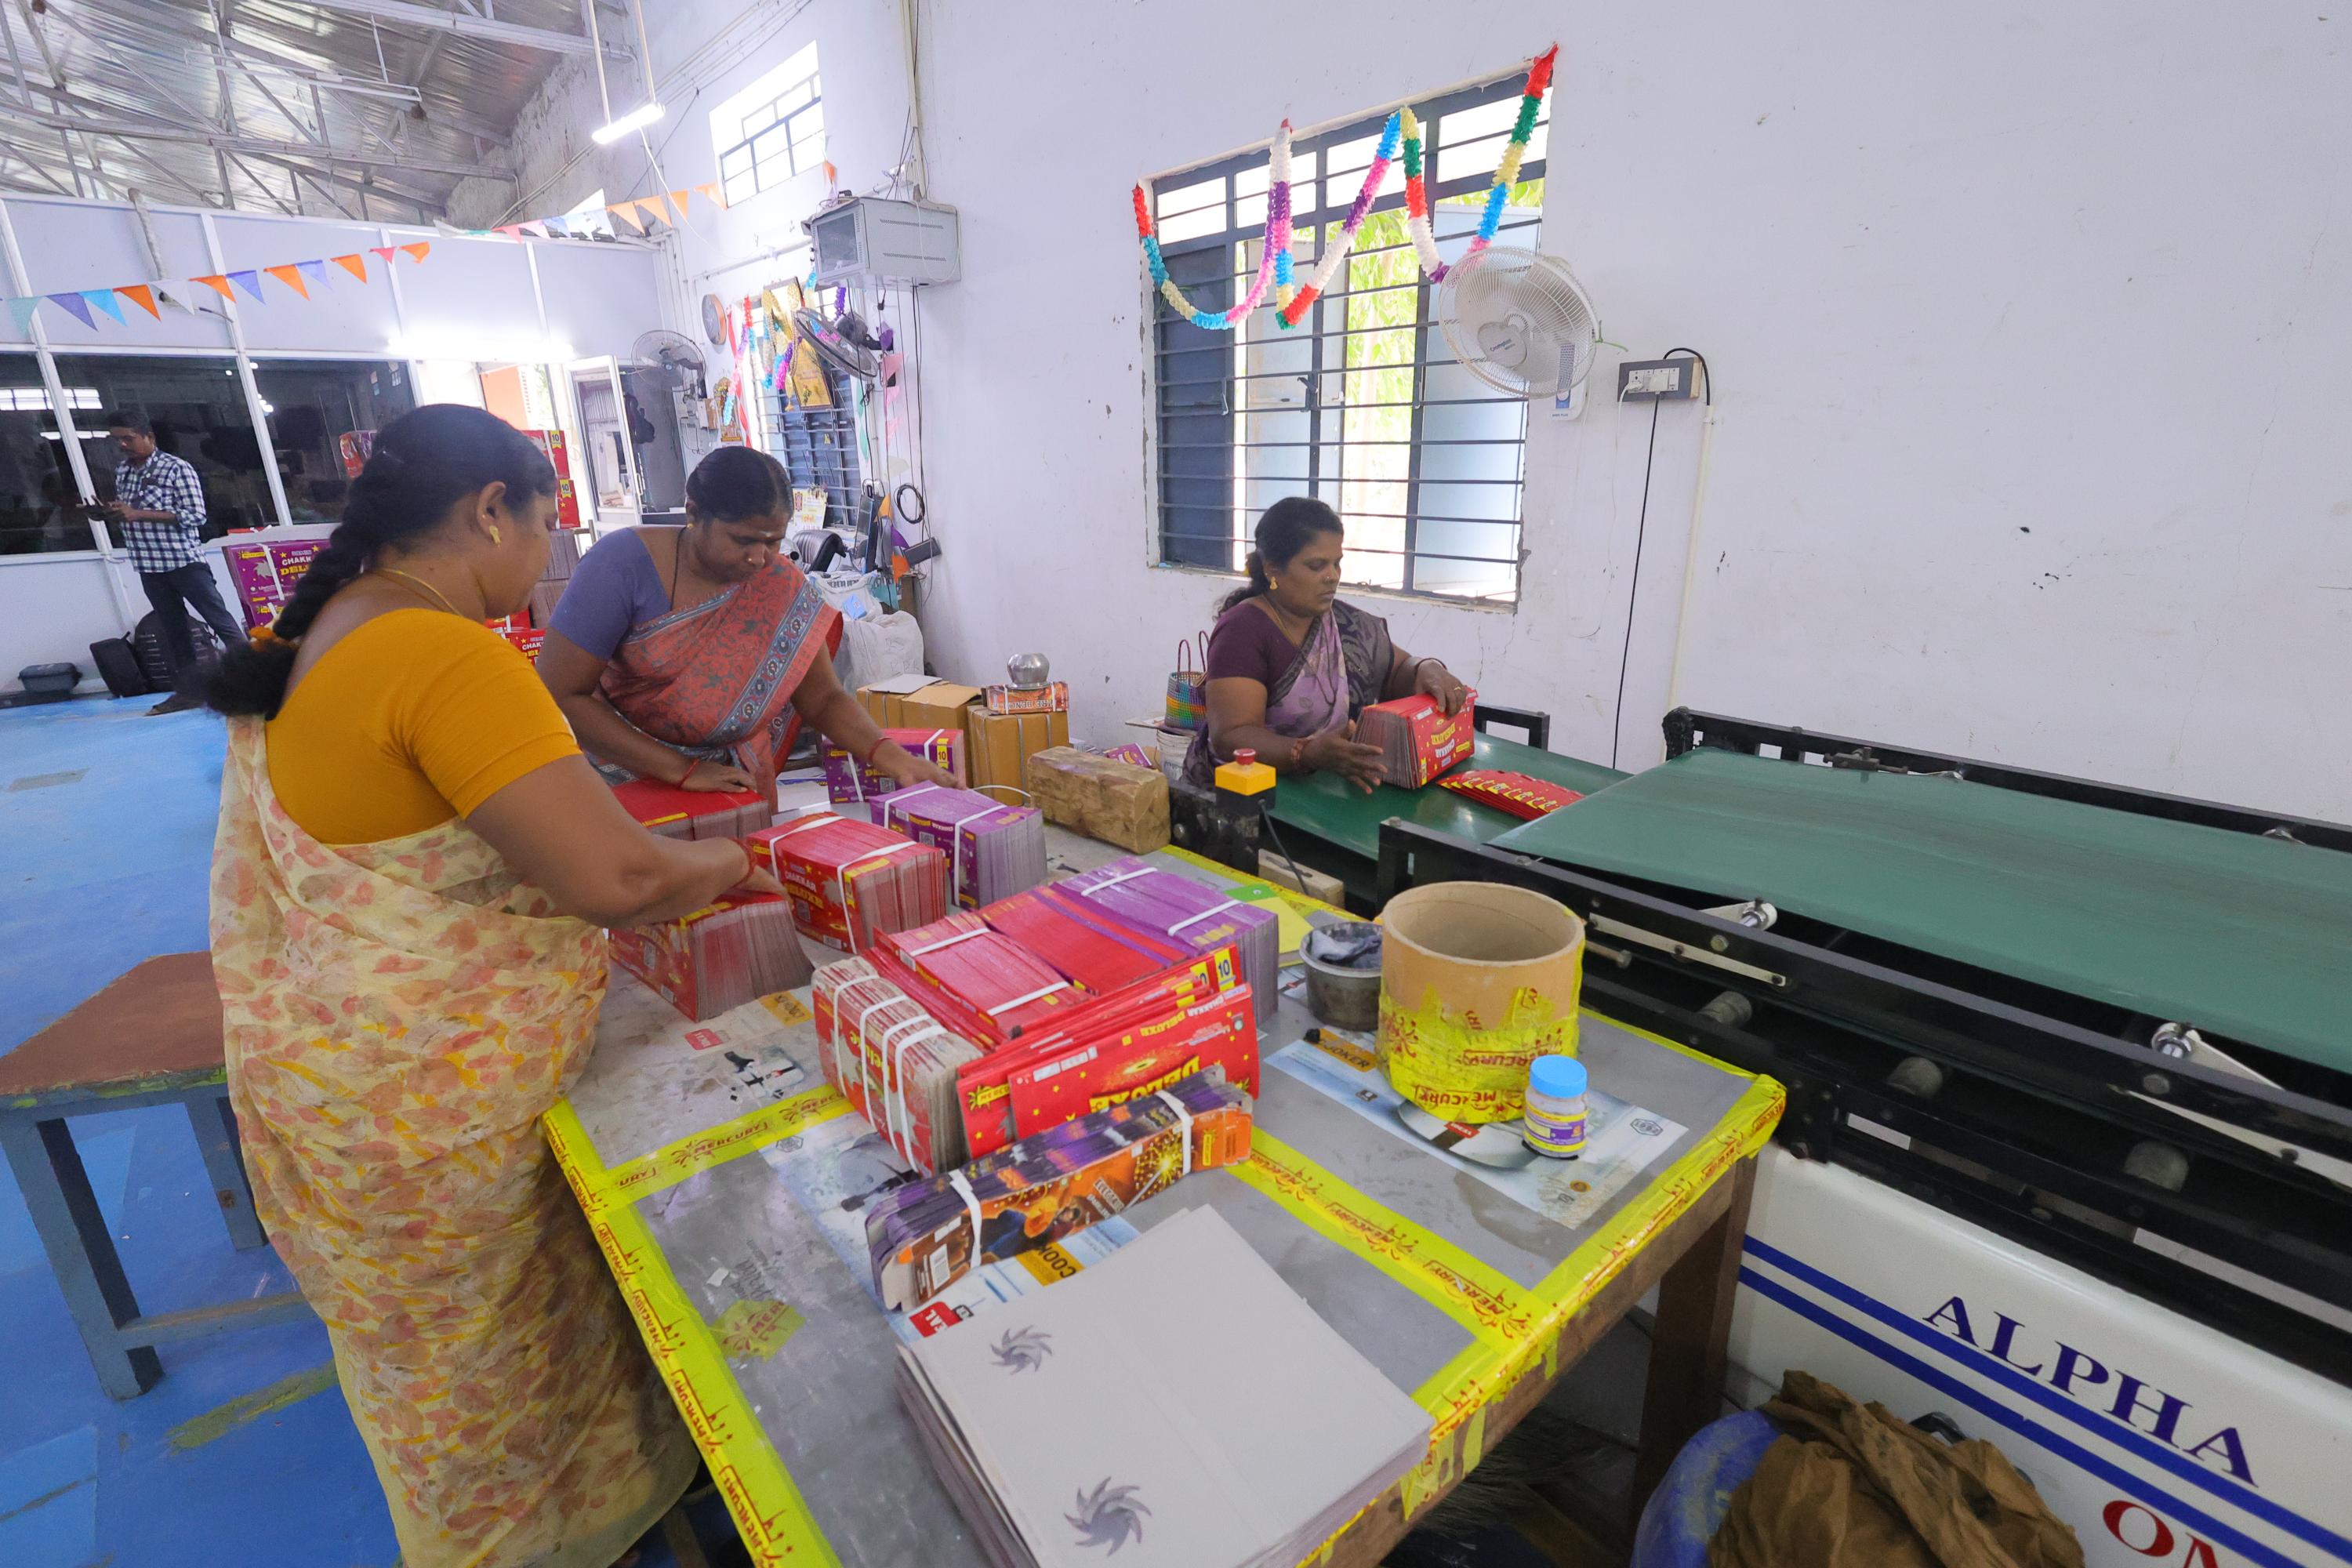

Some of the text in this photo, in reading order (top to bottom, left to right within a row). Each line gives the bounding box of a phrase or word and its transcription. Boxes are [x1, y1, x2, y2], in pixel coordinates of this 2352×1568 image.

[550, 433, 560, 441] 10
[938, 750, 946, 760] 10
[1218, 958, 1231, 978] 10
[694, 1123, 760, 1153] MERCURY
[1039, 1243, 1077, 1278] COOK
[1922, 1296, 2259, 1488] ALPHA
